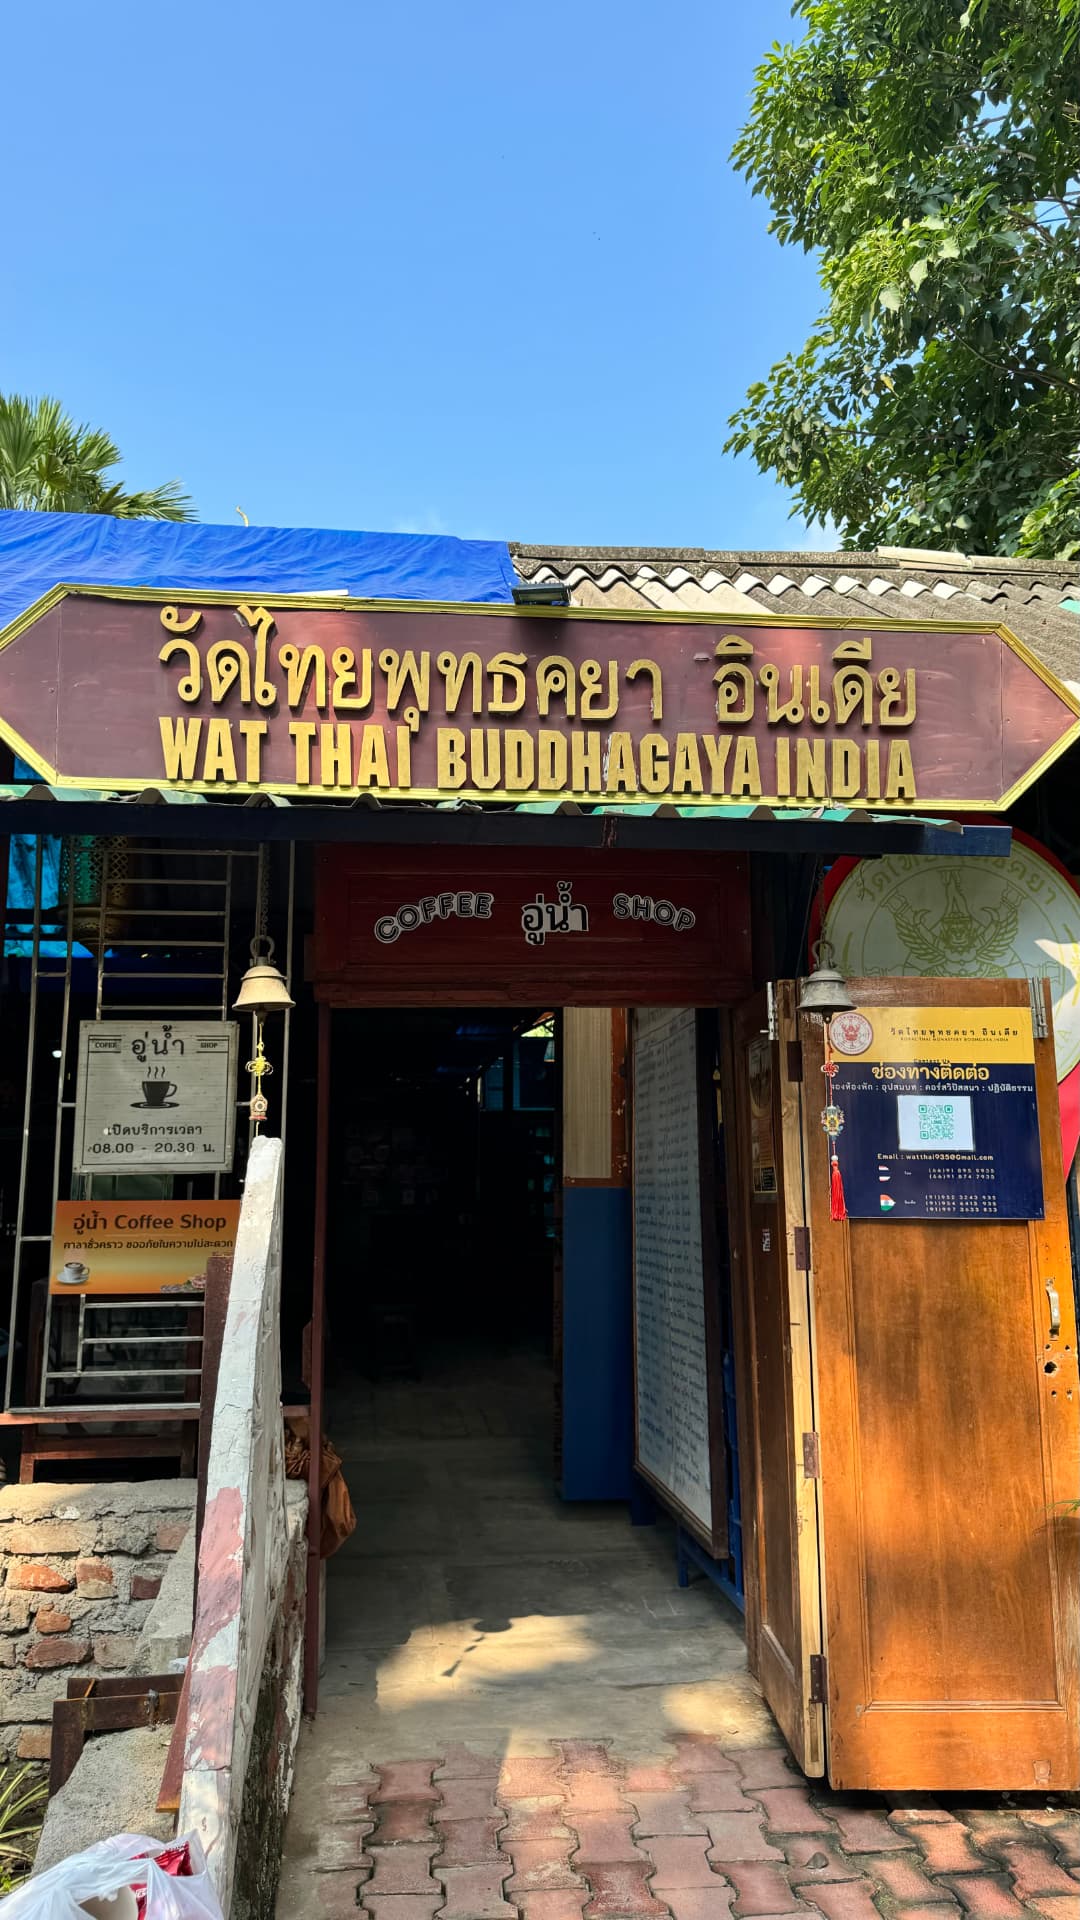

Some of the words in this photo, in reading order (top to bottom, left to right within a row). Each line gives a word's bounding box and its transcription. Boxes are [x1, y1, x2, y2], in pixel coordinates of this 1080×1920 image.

[158, 604, 664, 734] วัดไทยพุทธคยา
[711, 634, 918, 728] อินเดีย
[158, 716, 267, 786] WAT
[288, 720, 412, 790] THAI
[437, 727, 762, 798] BUDDHAGAYA
[775, 736, 917, 800] INDIA
[374, 892, 495, 944] COFFEE
[521, 880, 590, 946] อู่น้ำ
[612, 893, 696, 931] SHOP
[131, 1024, 185, 1063] อู่น้ำ
[871, 1061, 990, 1081] ช่องทางติดต่อ
[105, 1123, 203, 1137] เปิดบริการเวลา
[92, 1143, 134, 1154] 08.00
[154, 1143, 195, 1154] 20.30
[73, 1210, 108, 1235] อู่น้ำ
[114, 1214, 174, 1230] Coffee
[180, 1214, 227, 1232] Shop
